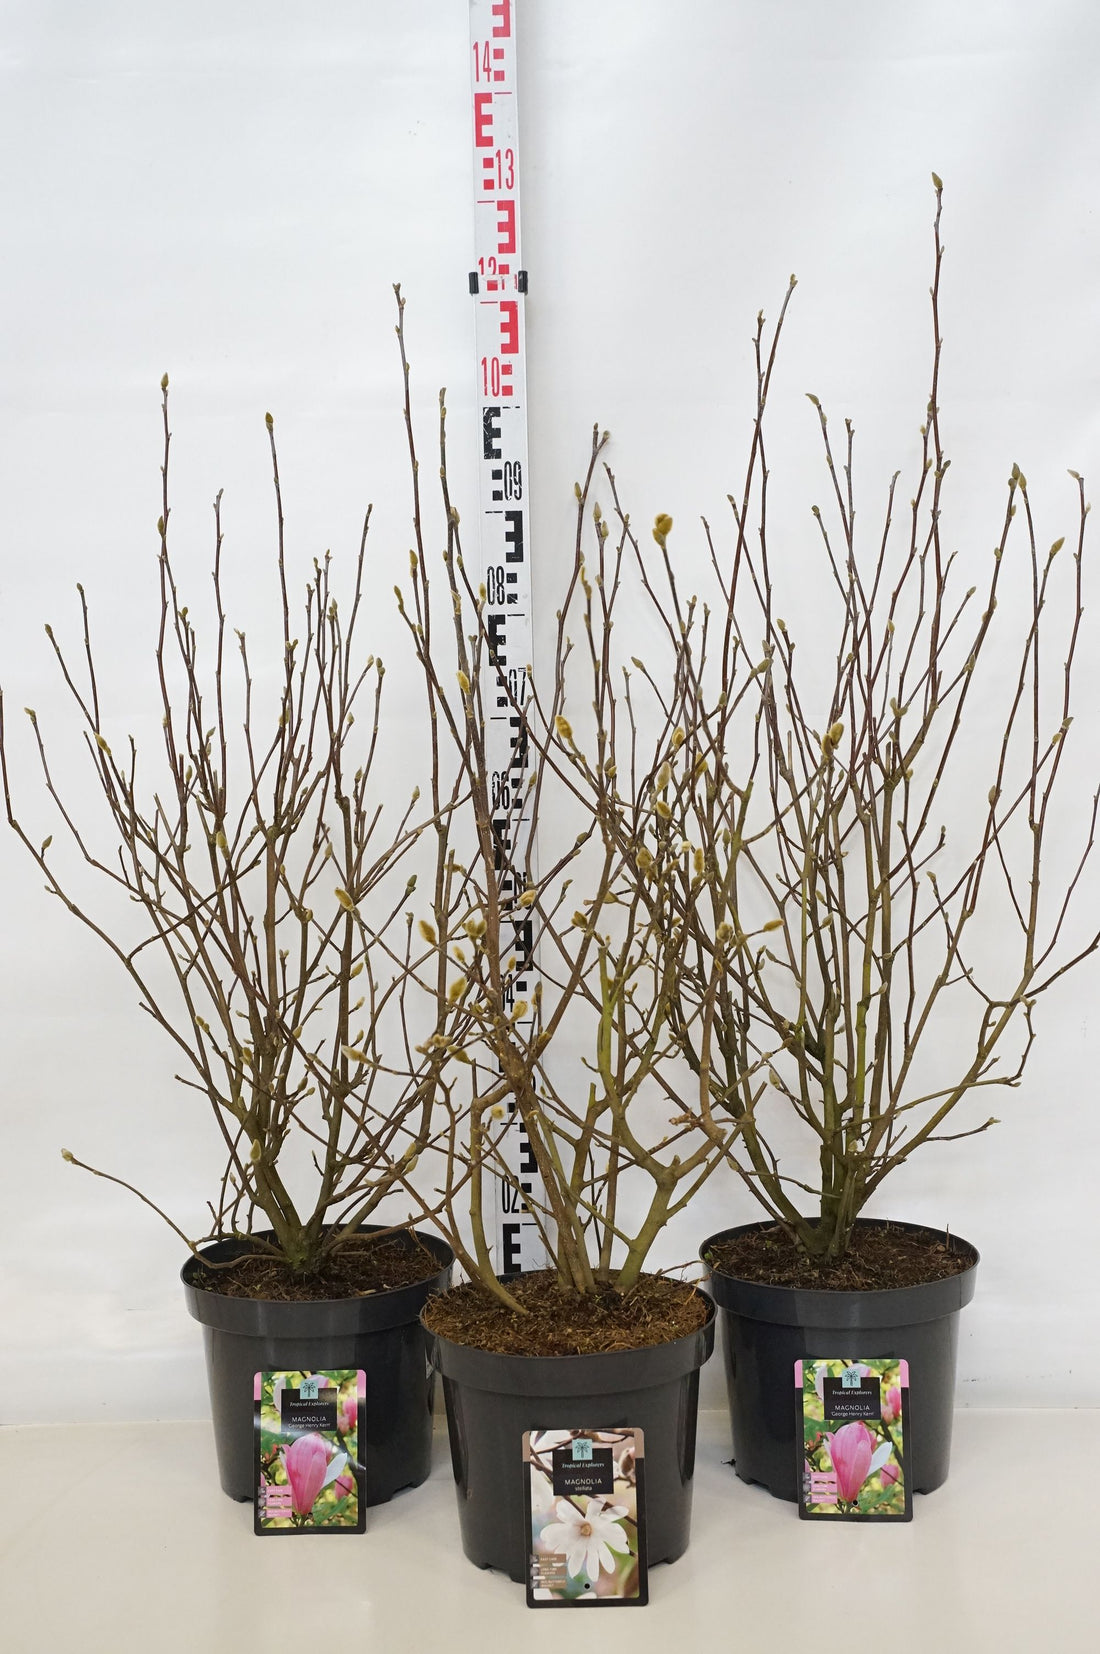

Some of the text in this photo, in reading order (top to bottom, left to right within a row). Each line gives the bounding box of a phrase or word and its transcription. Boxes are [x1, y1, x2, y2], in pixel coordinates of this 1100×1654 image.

[472, 41, 492, 82] 14
[495, 148, 515, 190] 13
[481, 357, 500, 397] 10
[503, 460, 523, 502] 09
[486, 565, 506, 606] 08
